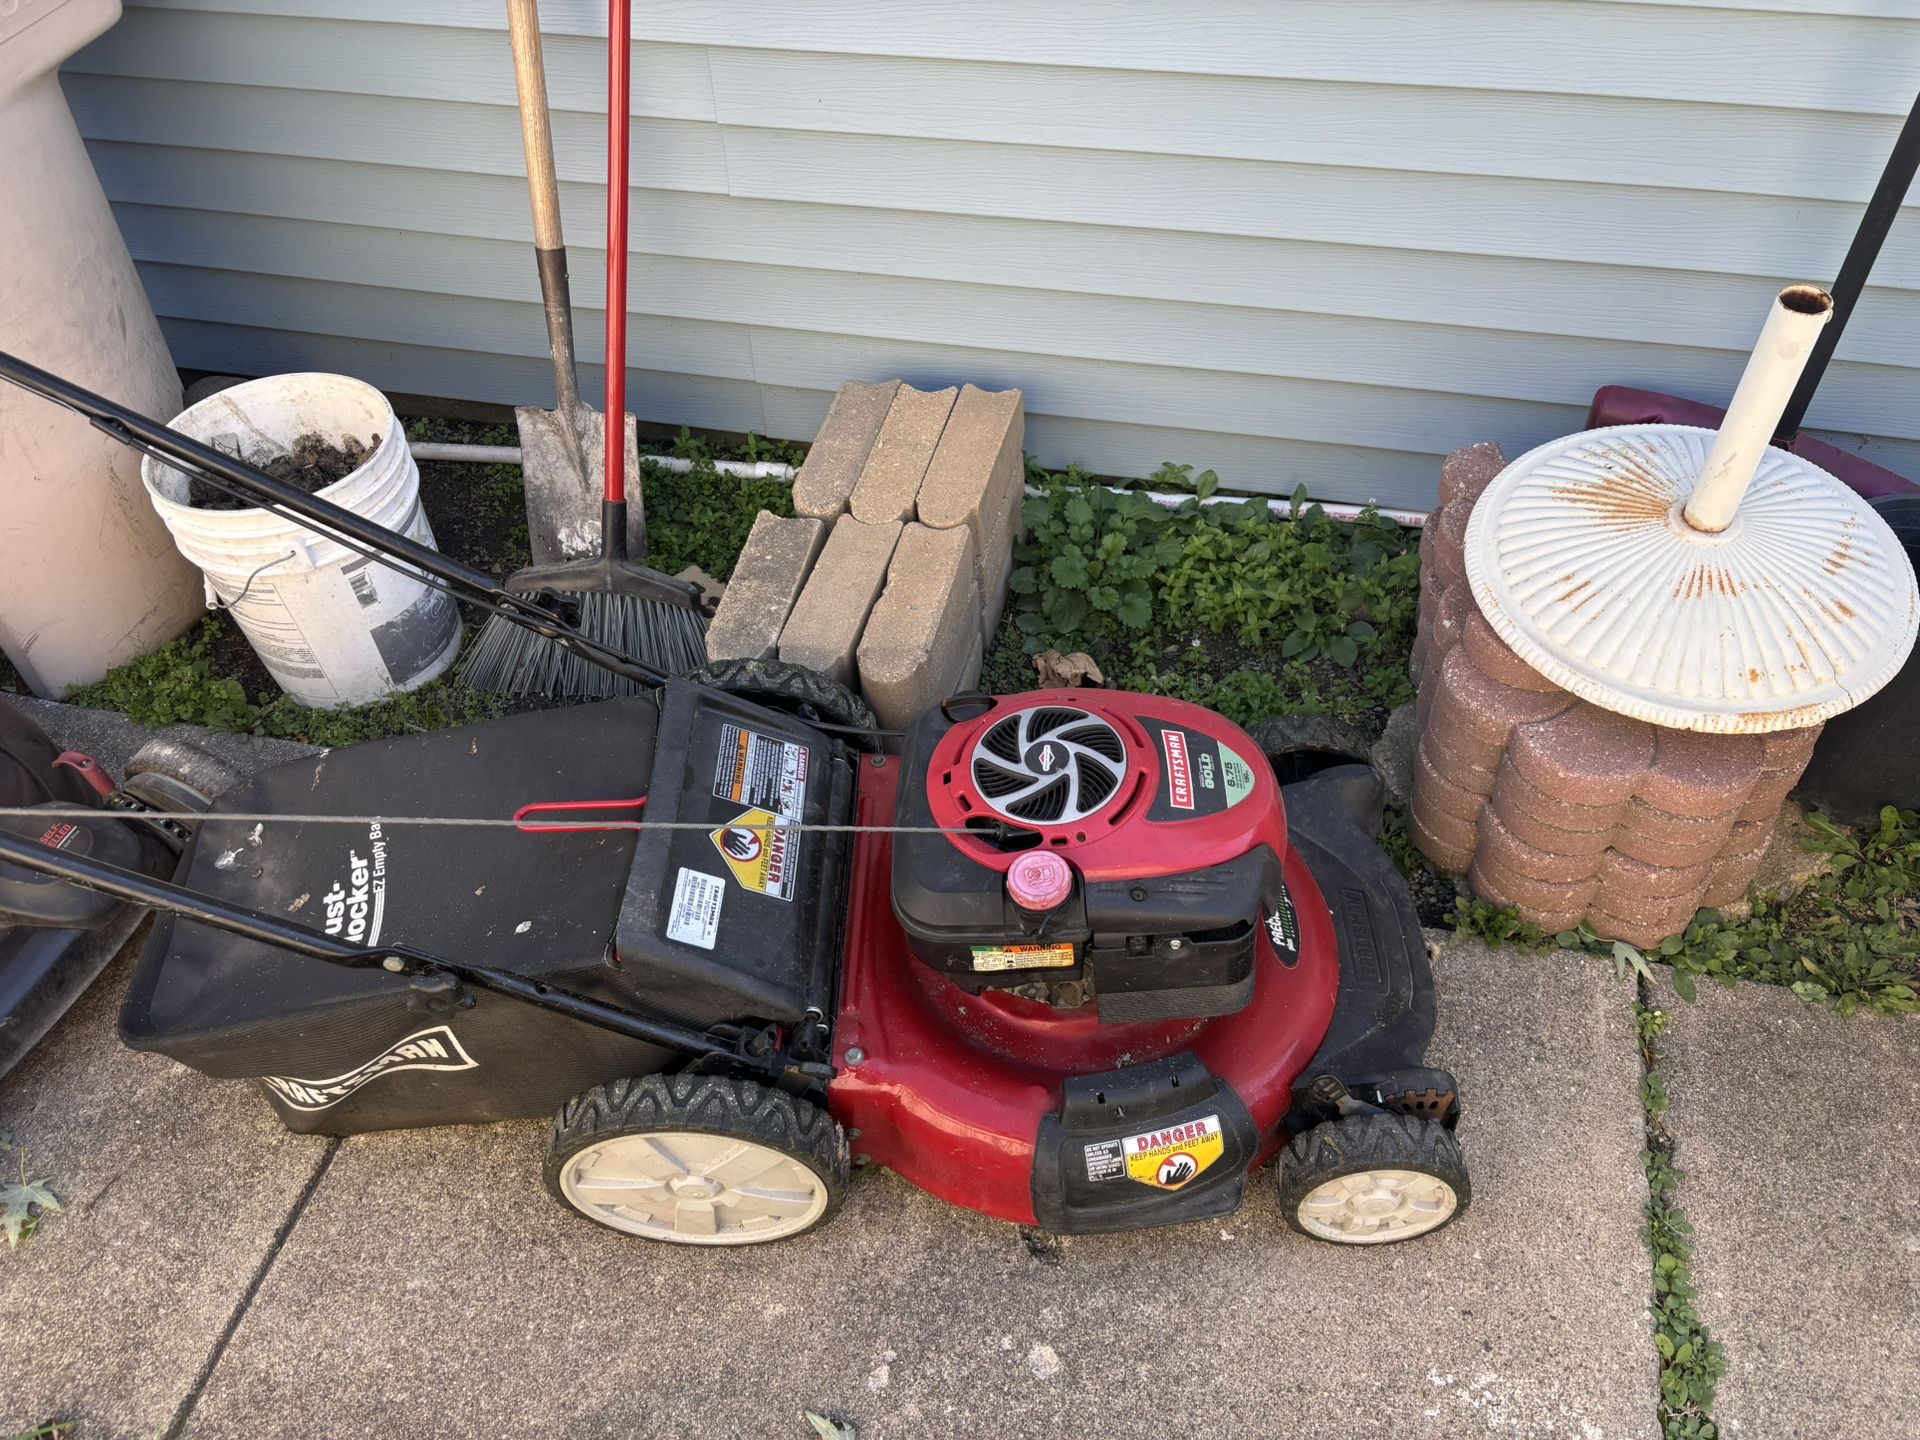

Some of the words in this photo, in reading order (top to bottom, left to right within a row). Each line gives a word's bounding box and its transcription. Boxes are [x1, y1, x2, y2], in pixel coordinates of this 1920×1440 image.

[734, 750, 746, 785] WARNING
[1167, 735, 1188, 802] CRAFTSMAN
[1200, 753, 1215, 789] GOLD
[1224, 762, 1236, 787] 6.75
[49, 824, 72, 848] ELLED
[371, 842, 387, 877] Empty
[760, 858, 768, 871] FEET
[768, 827, 786, 884] DANGER
[372, 878, 385, 893] EZ
[758, 872, 766, 888] AWAY
[323, 882, 345, 934] ust-
[1130, 1152, 1148, 1162] KEEP
[1148, 1146, 1171, 1158] HANDS
[1172, 1144, 1184, 1152] and
[1184, 1138, 1200, 1149] FEET
[1201, 1133, 1218, 1144] AWAY
[1137, 1122, 1207, 1151] DANGER
